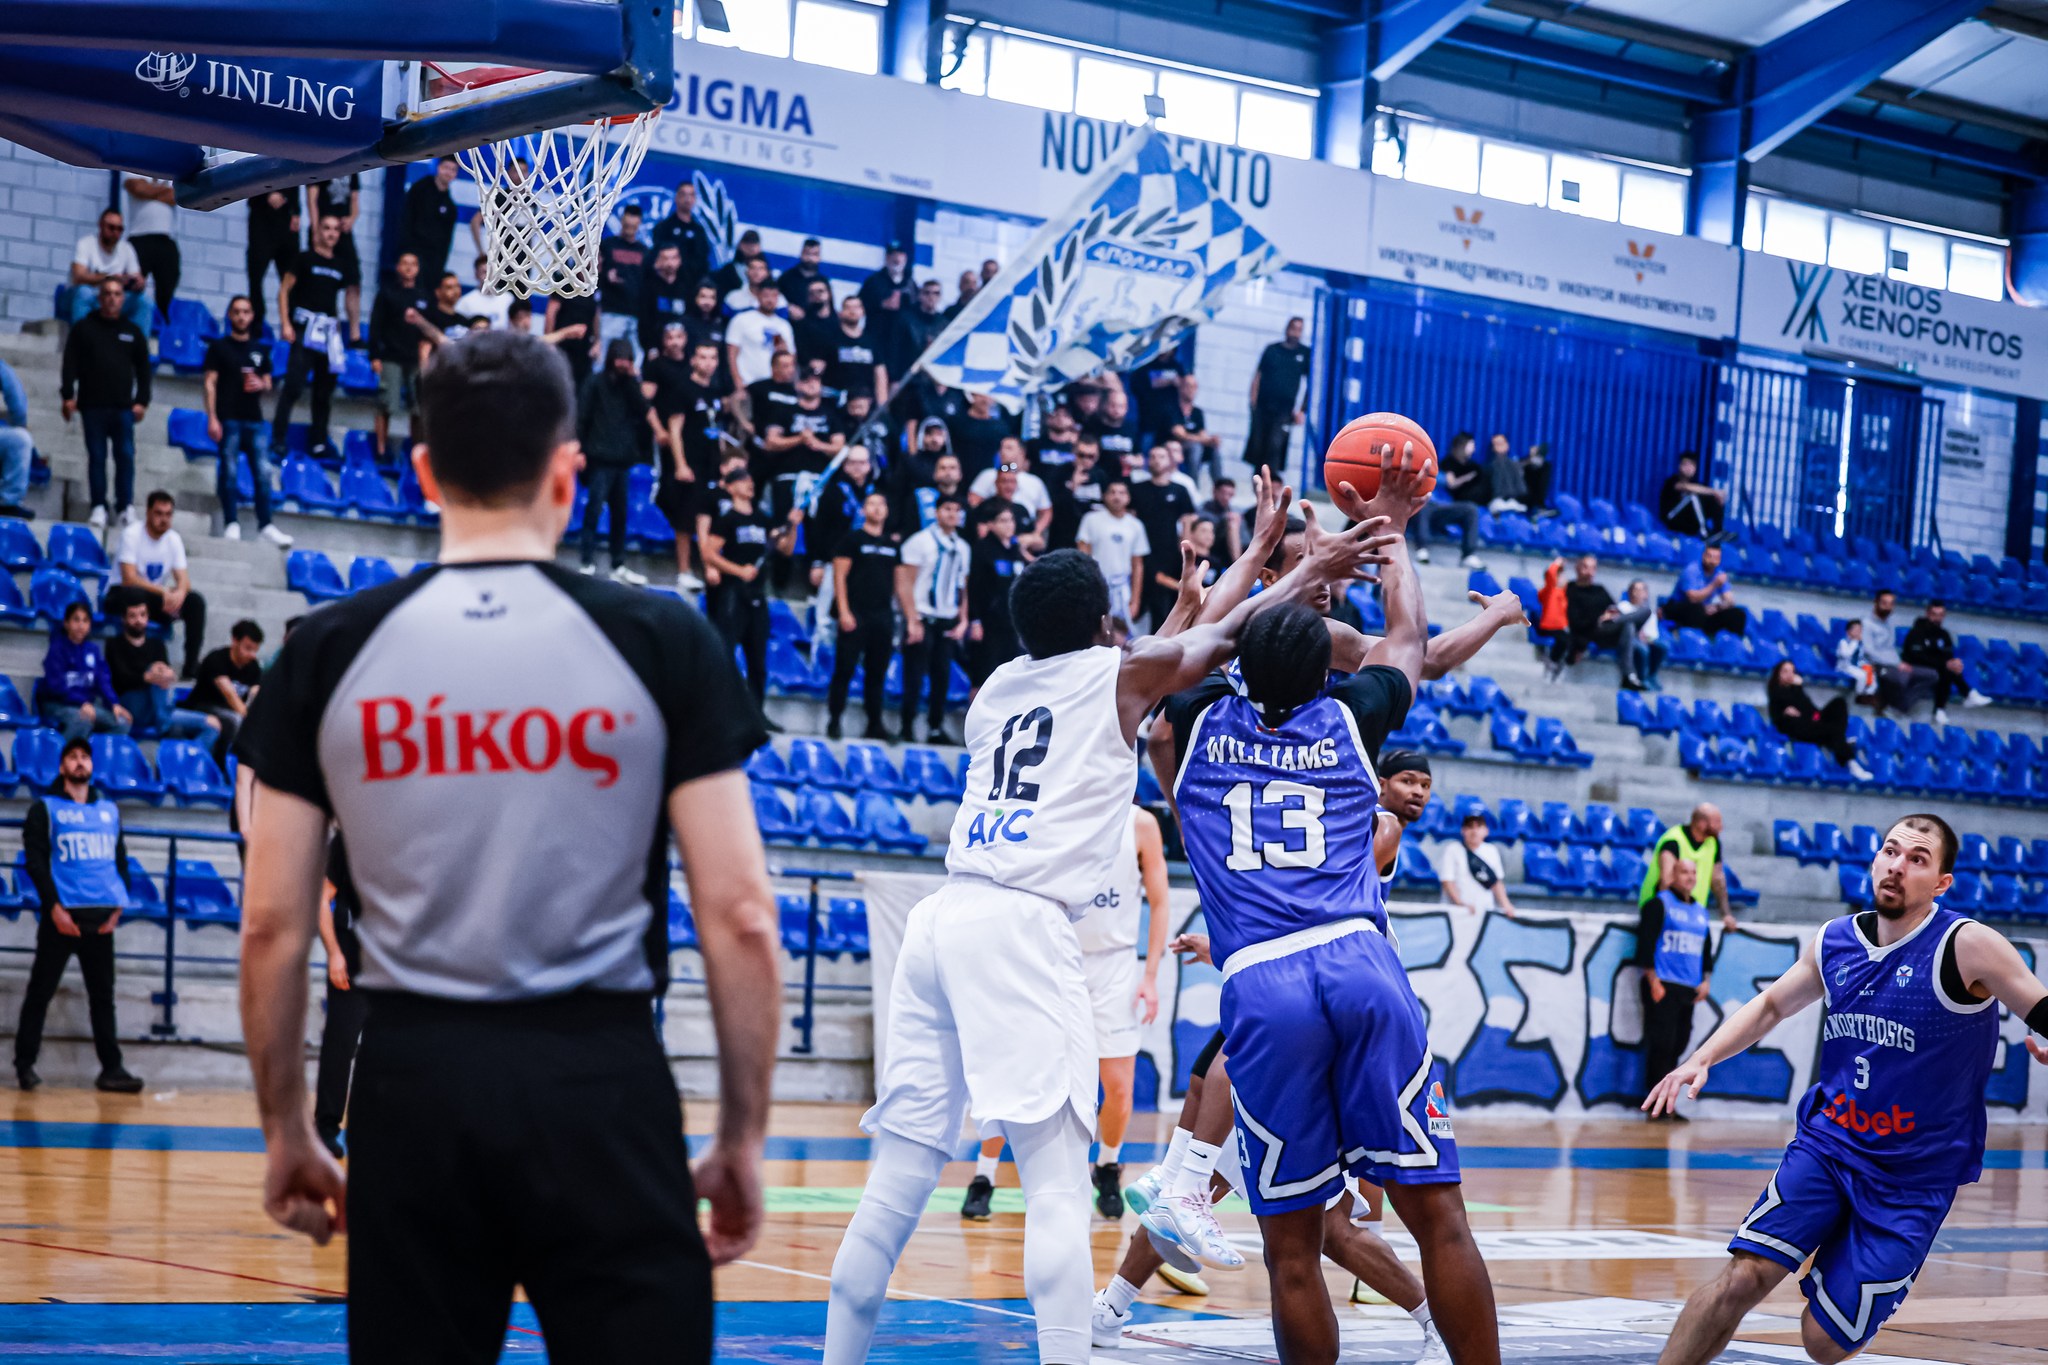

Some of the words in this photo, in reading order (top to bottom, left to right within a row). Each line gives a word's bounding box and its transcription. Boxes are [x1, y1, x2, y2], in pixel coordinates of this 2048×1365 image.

[203, 60, 356, 121] JINLING
[655, 121, 814, 169] COATINGS
[1042, 111, 1271, 208] NOVNTO
[1842, 272, 1942, 315] XENIOS
[1840, 302, 2023, 361] XENOFONTOS
[988, 706, 1053, 802] 12
[1206, 734, 1339, 771] WILLIAMS
[1222, 780, 1327, 871] 13
[1823, 1013, 1916, 1053] ANORTHOSIS
[1853, 1055, 1871, 1090] 3
